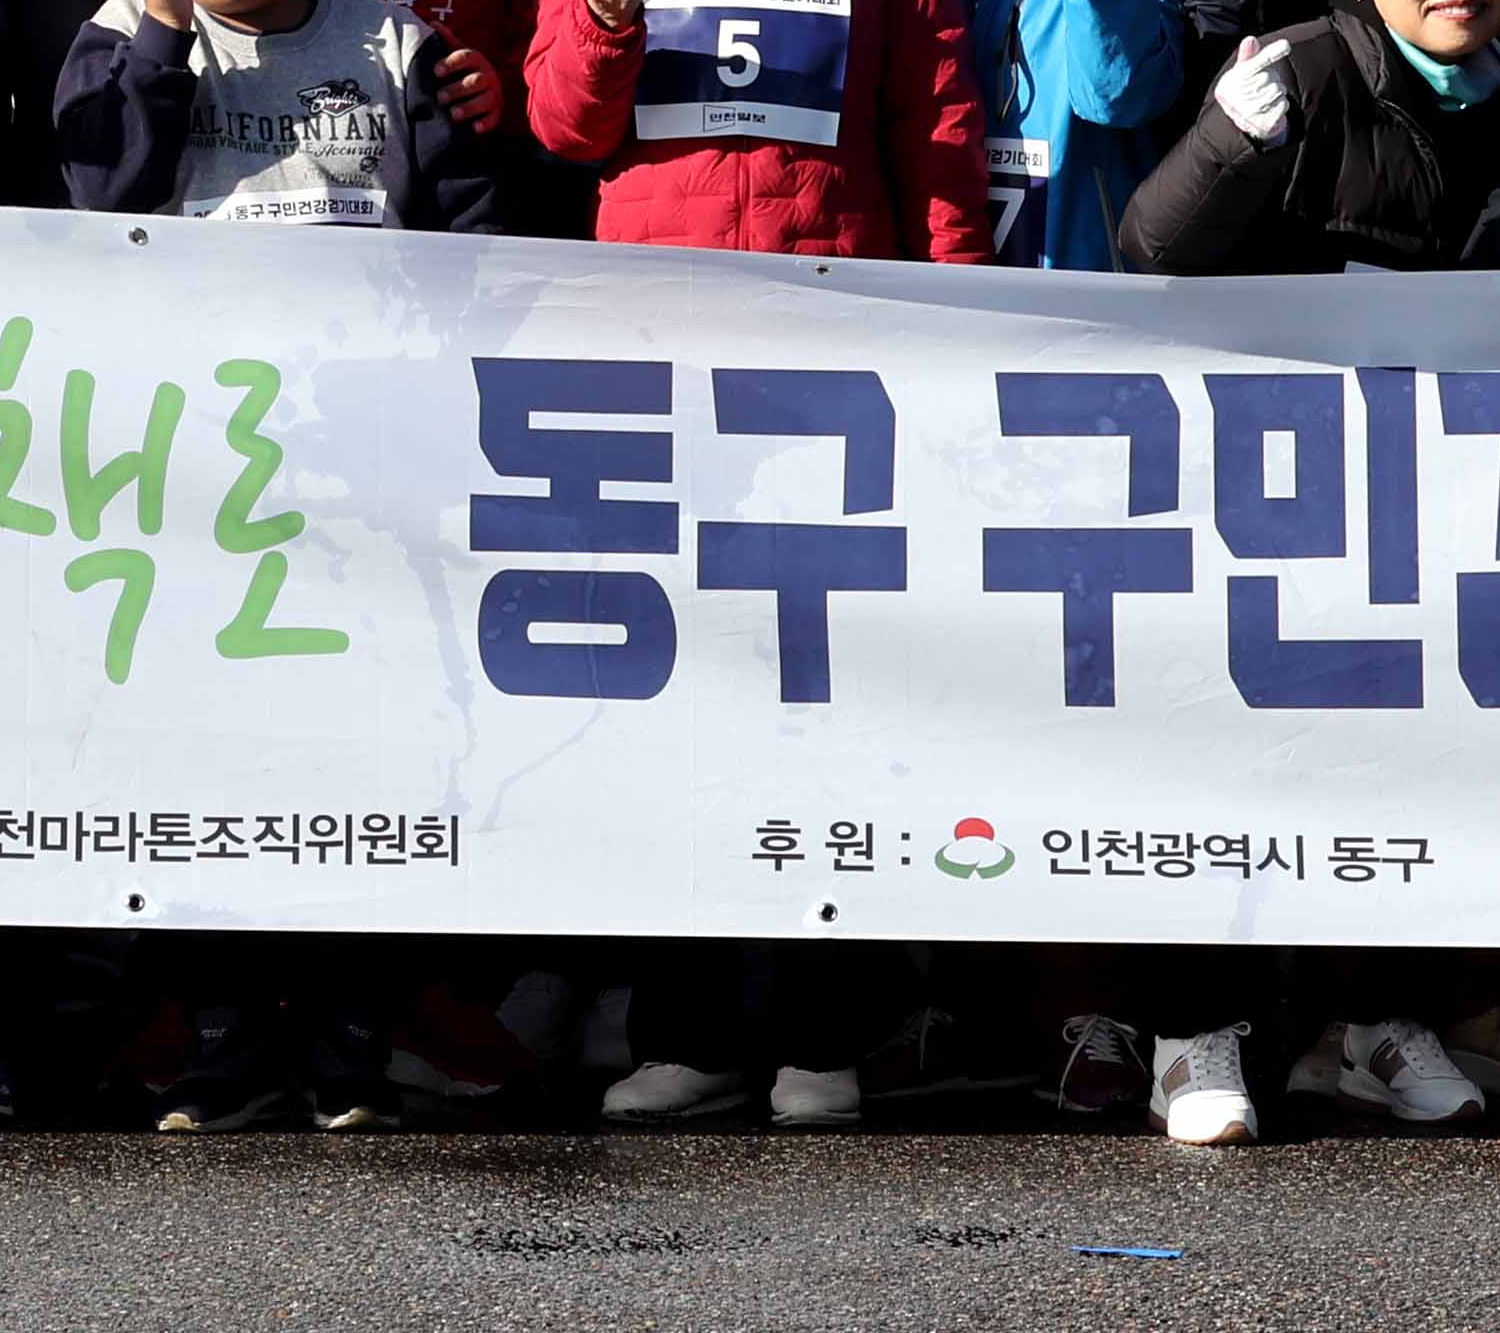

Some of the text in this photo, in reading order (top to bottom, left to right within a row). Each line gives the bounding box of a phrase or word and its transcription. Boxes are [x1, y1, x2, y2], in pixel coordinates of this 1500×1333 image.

[716, 19, 761, 88] 5
[267, 199, 374, 218] 구민건강걷기대회
[469, 356, 908, 703] 동구
[1042, 829, 1306, 881] 인천광역시
[1328, 837, 1436, 883] 동구
